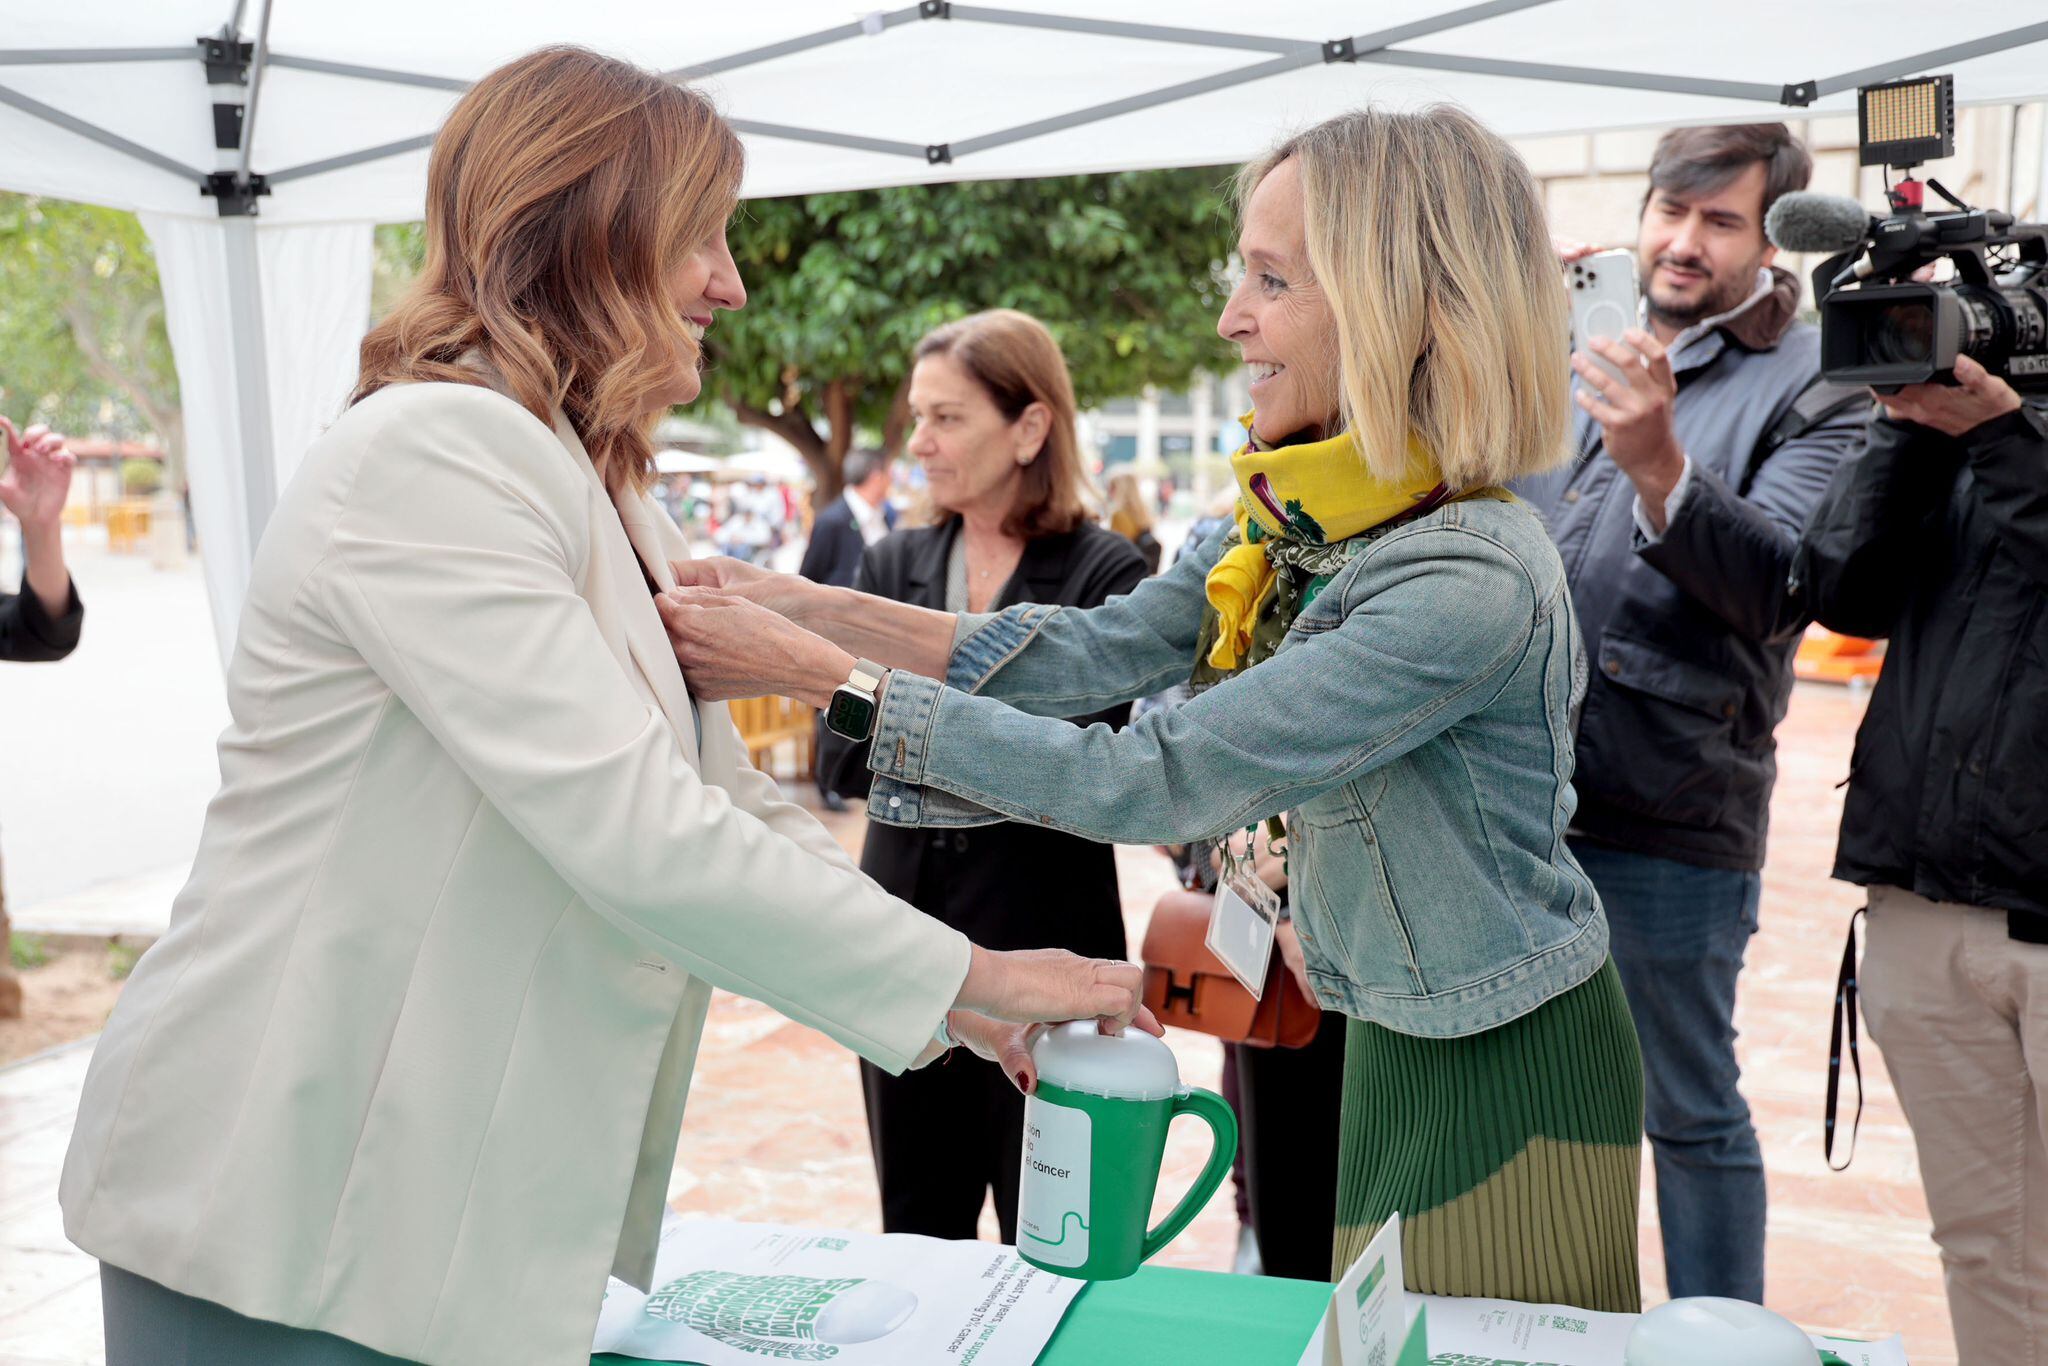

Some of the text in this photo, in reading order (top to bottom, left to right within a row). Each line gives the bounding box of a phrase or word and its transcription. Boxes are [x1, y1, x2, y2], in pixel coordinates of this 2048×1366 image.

[1033, 1160, 1071, 1179] cáncer
[1012, 1278, 1030, 1294] past
[946, 1328, 972, 1354] cancer
[980, 1323, 998, 1341] your
